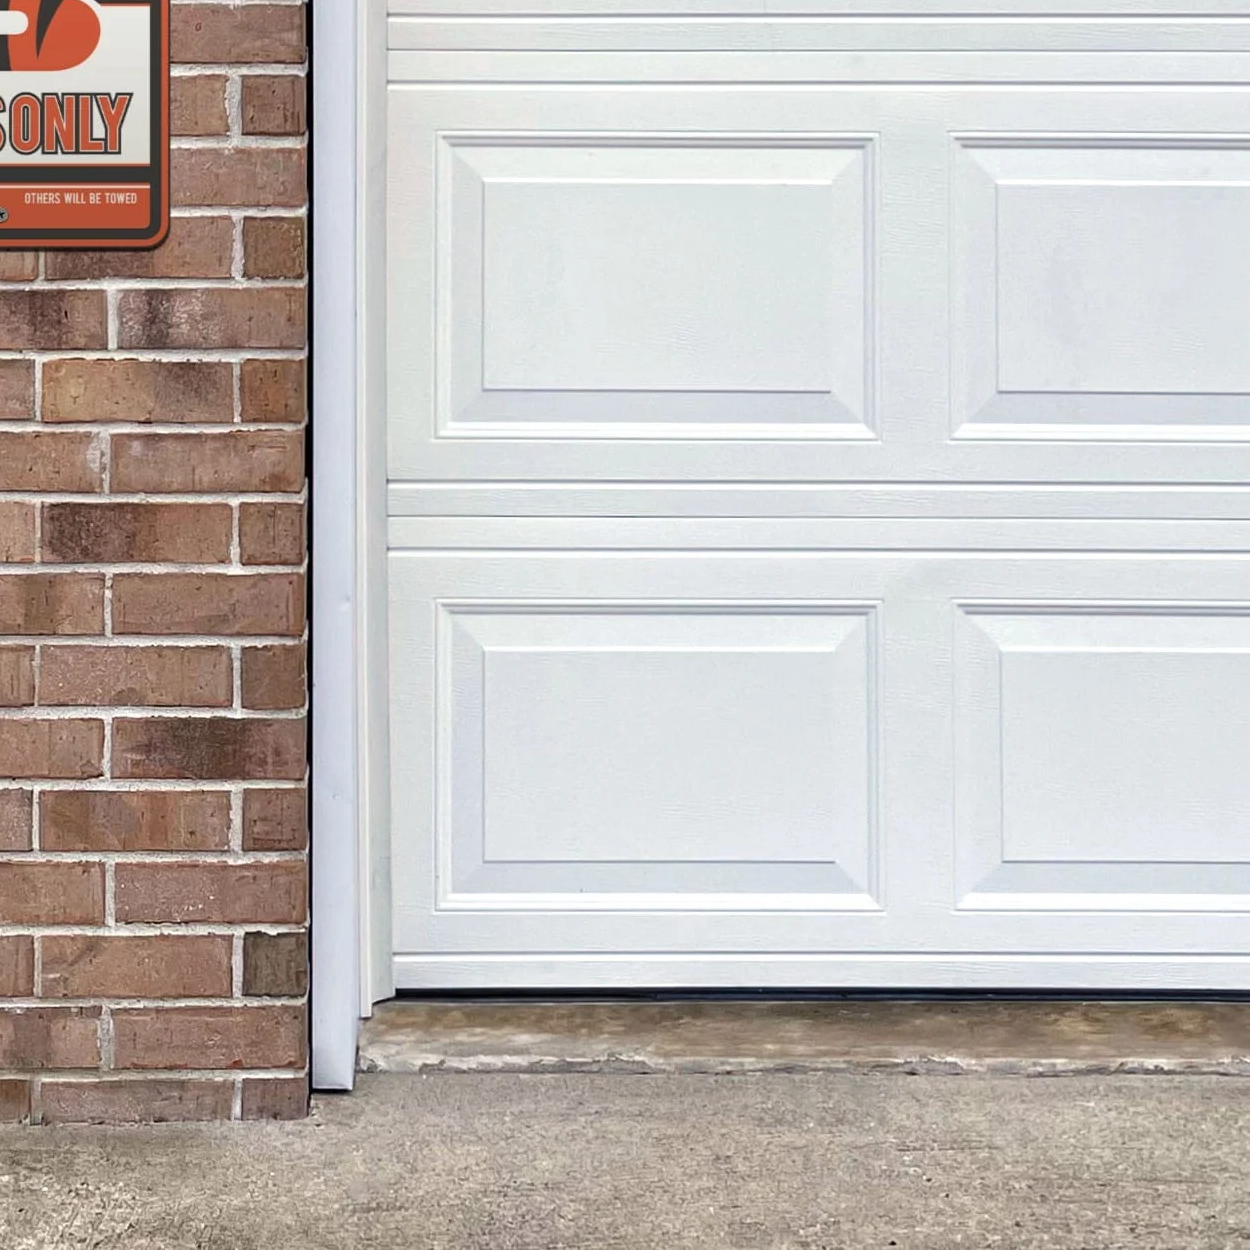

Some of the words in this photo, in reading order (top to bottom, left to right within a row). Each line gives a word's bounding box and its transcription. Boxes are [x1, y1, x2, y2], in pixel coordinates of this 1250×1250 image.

[24, 192, 61, 205] OTHERS
[64, 192, 86, 205] WILL
[89, 192, 102, 205] BE
[104, 192, 138, 205] TOWED
